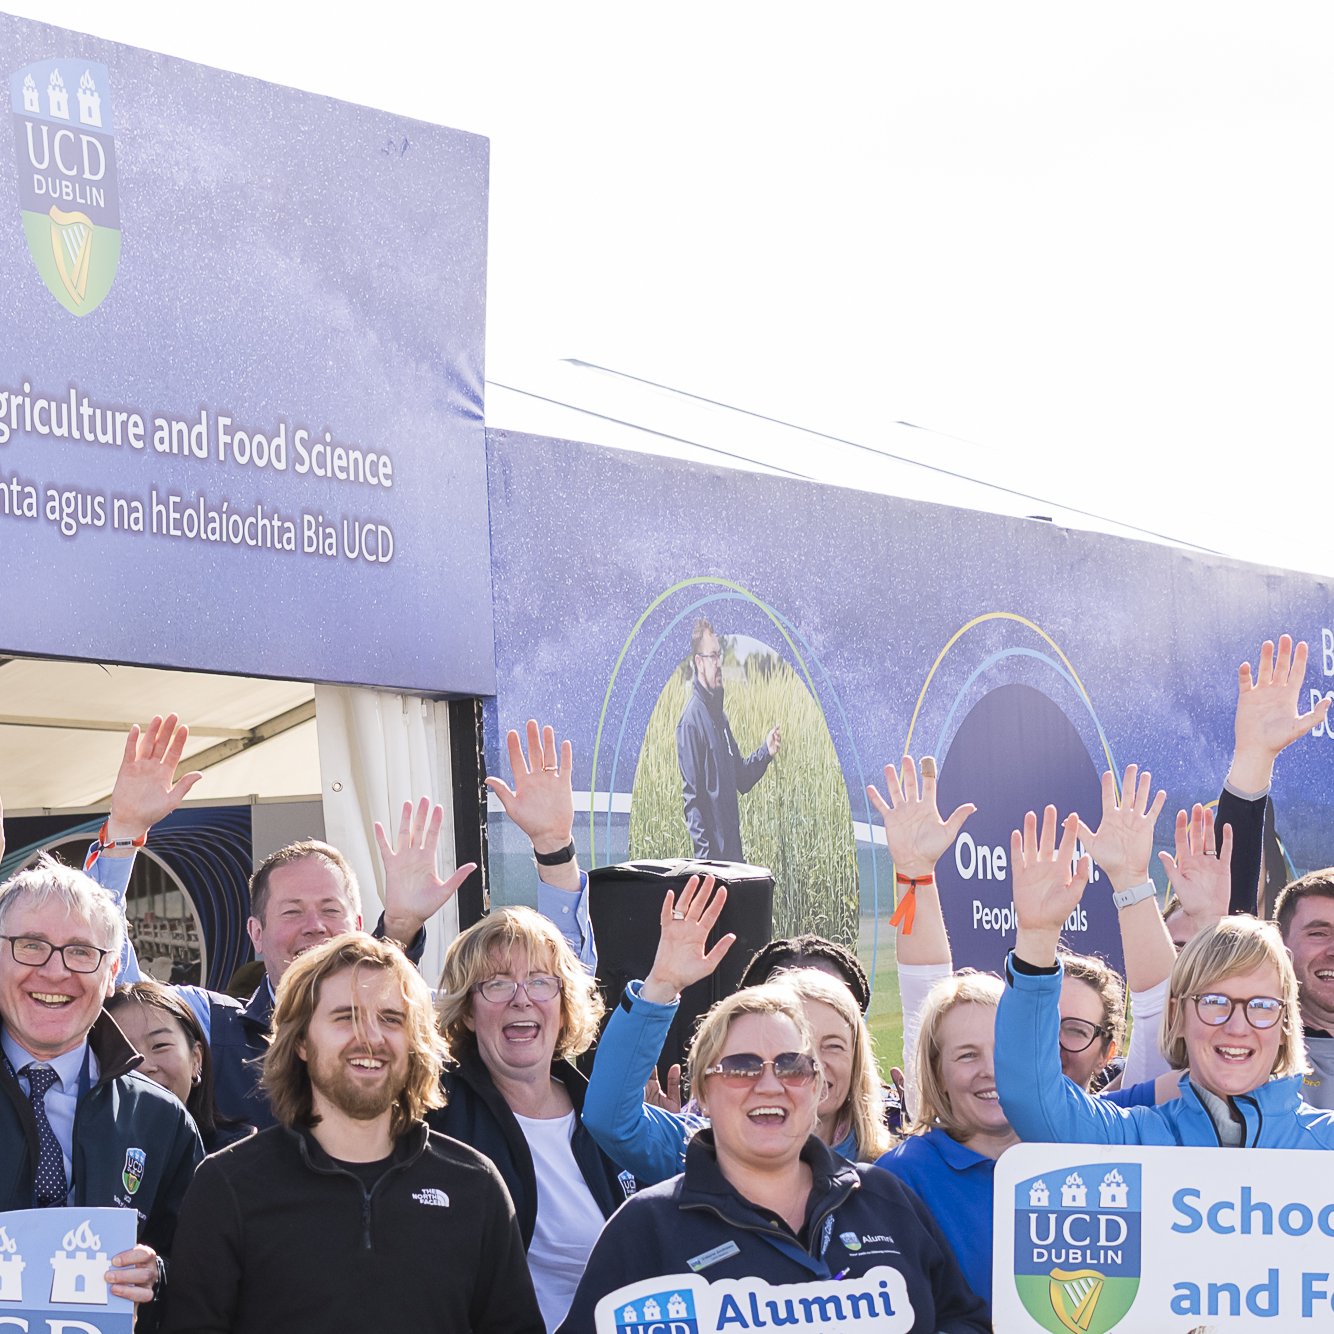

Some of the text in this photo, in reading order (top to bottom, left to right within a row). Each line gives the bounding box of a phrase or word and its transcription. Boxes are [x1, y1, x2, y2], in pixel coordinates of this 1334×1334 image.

[24, 122, 107, 182] UCD
[33, 175, 105, 209] DUBLIN
[154, 409, 208, 460] and
[218, 416, 286, 471] Food
[296, 427, 393, 488] Science
[46, 486, 105, 537] agus
[114, 500, 143, 531] na
[153, 494, 295, 551] hEolaíochta
[303, 513, 337, 558] Bia
[344, 521, 394, 564] UCD
[955, 831, 1007, 881] One
[1303, 1077, 1321, 1087] bro
[127, 1158, 143, 1174] UCD
[411, 1192, 437, 1200] NORTH
[862, 1234, 894, 1243] Alumni
[1028, 1212, 1128, 1248] UCD
[1033, 1248, 1122, 1265] DUBLIN
[716, 1279, 896, 1332] Alumni
[1170, 1268, 1279, 1317] and
